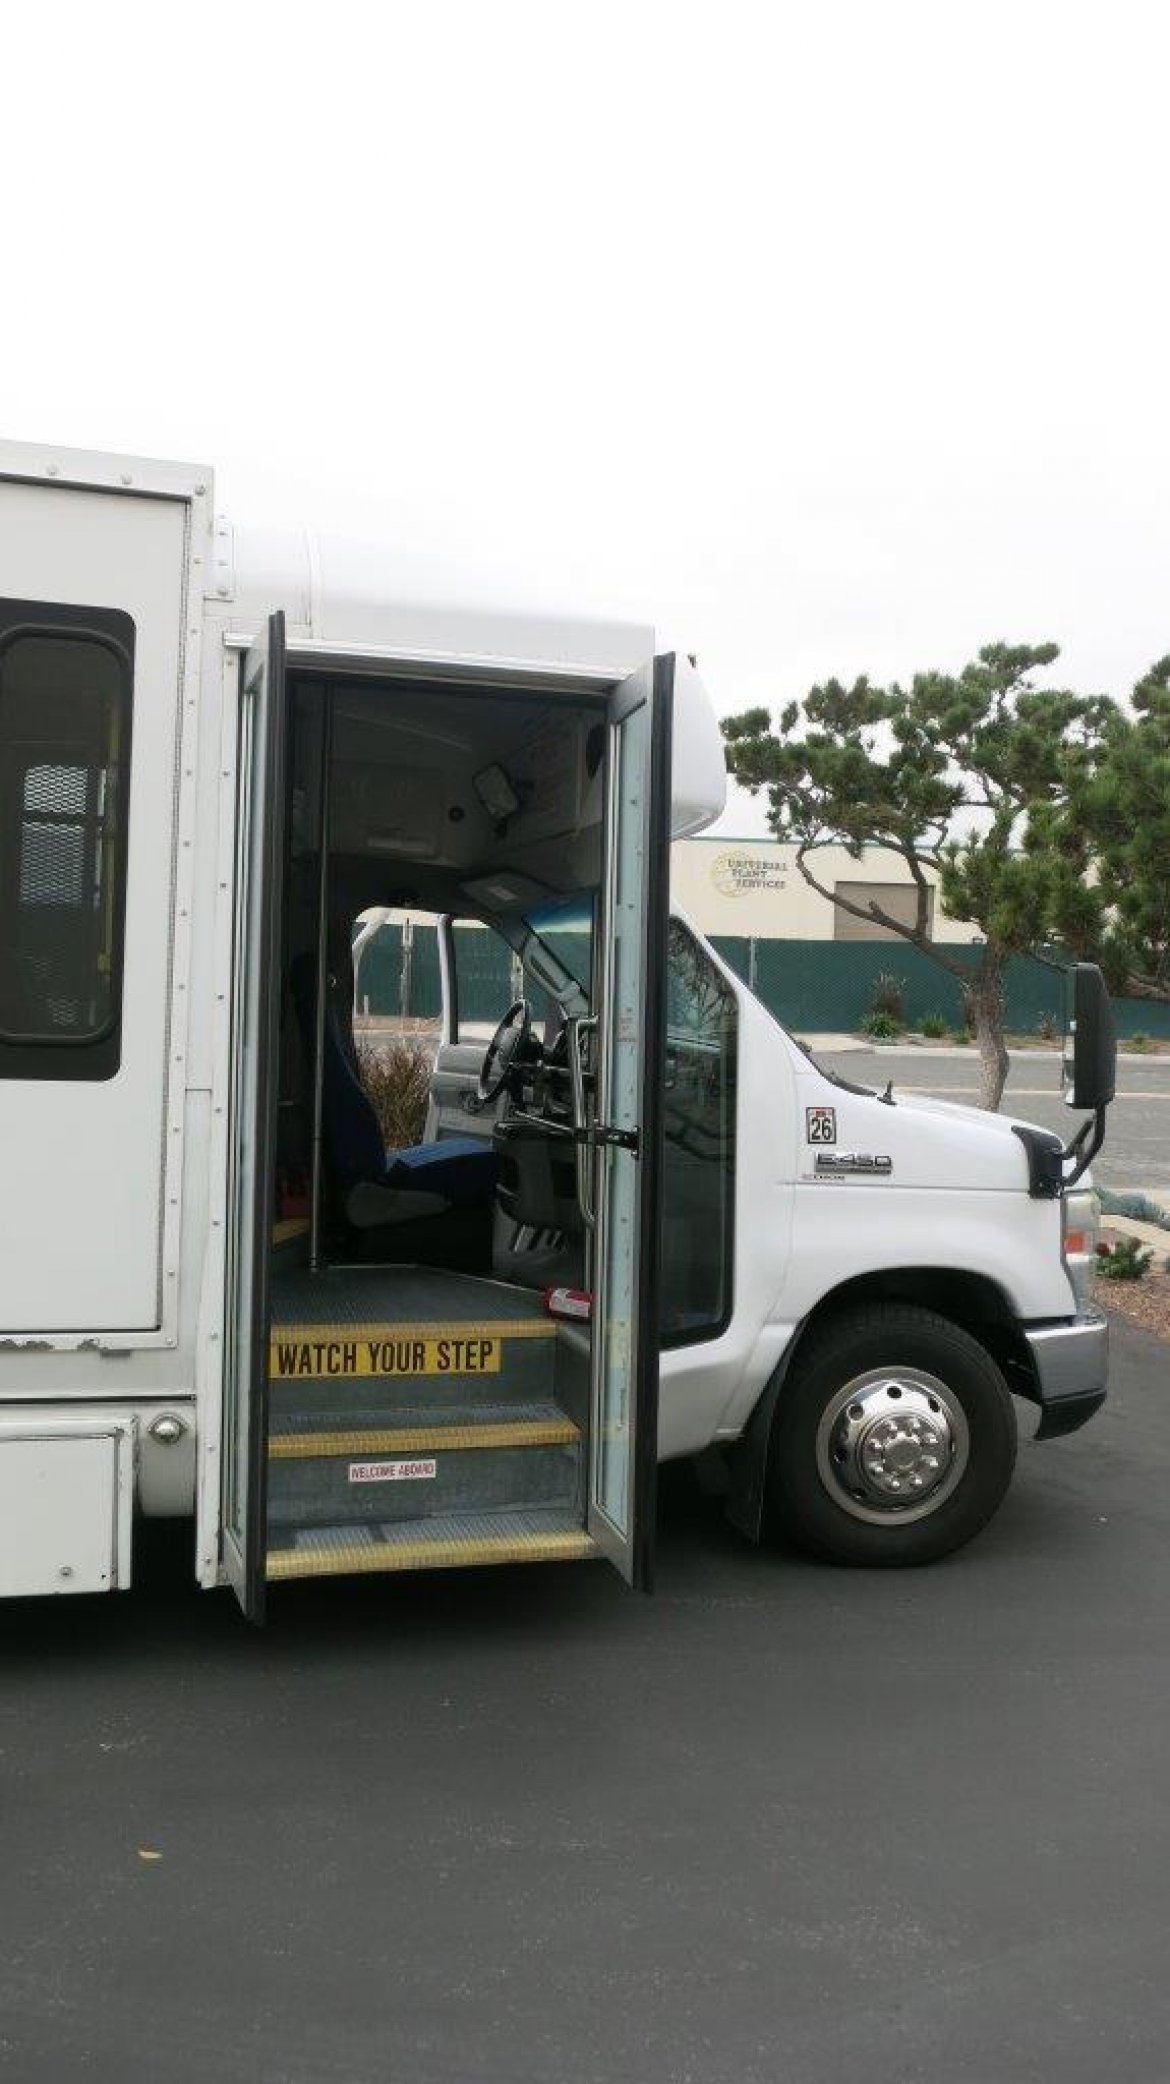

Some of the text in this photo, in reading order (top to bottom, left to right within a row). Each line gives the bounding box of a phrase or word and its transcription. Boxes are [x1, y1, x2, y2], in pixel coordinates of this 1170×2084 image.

[727, 859, 788, 871] UNIVERSAL
[732, 868, 768, 878] PLANT
[736, 879, 786, 889] SERVICES
[811, 1117, 832, 1140] 26
[278, 1340, 494, 1374] WATCH YOUR STEP
[351, 1462, 434, 1478] WELCOME ABOARD
